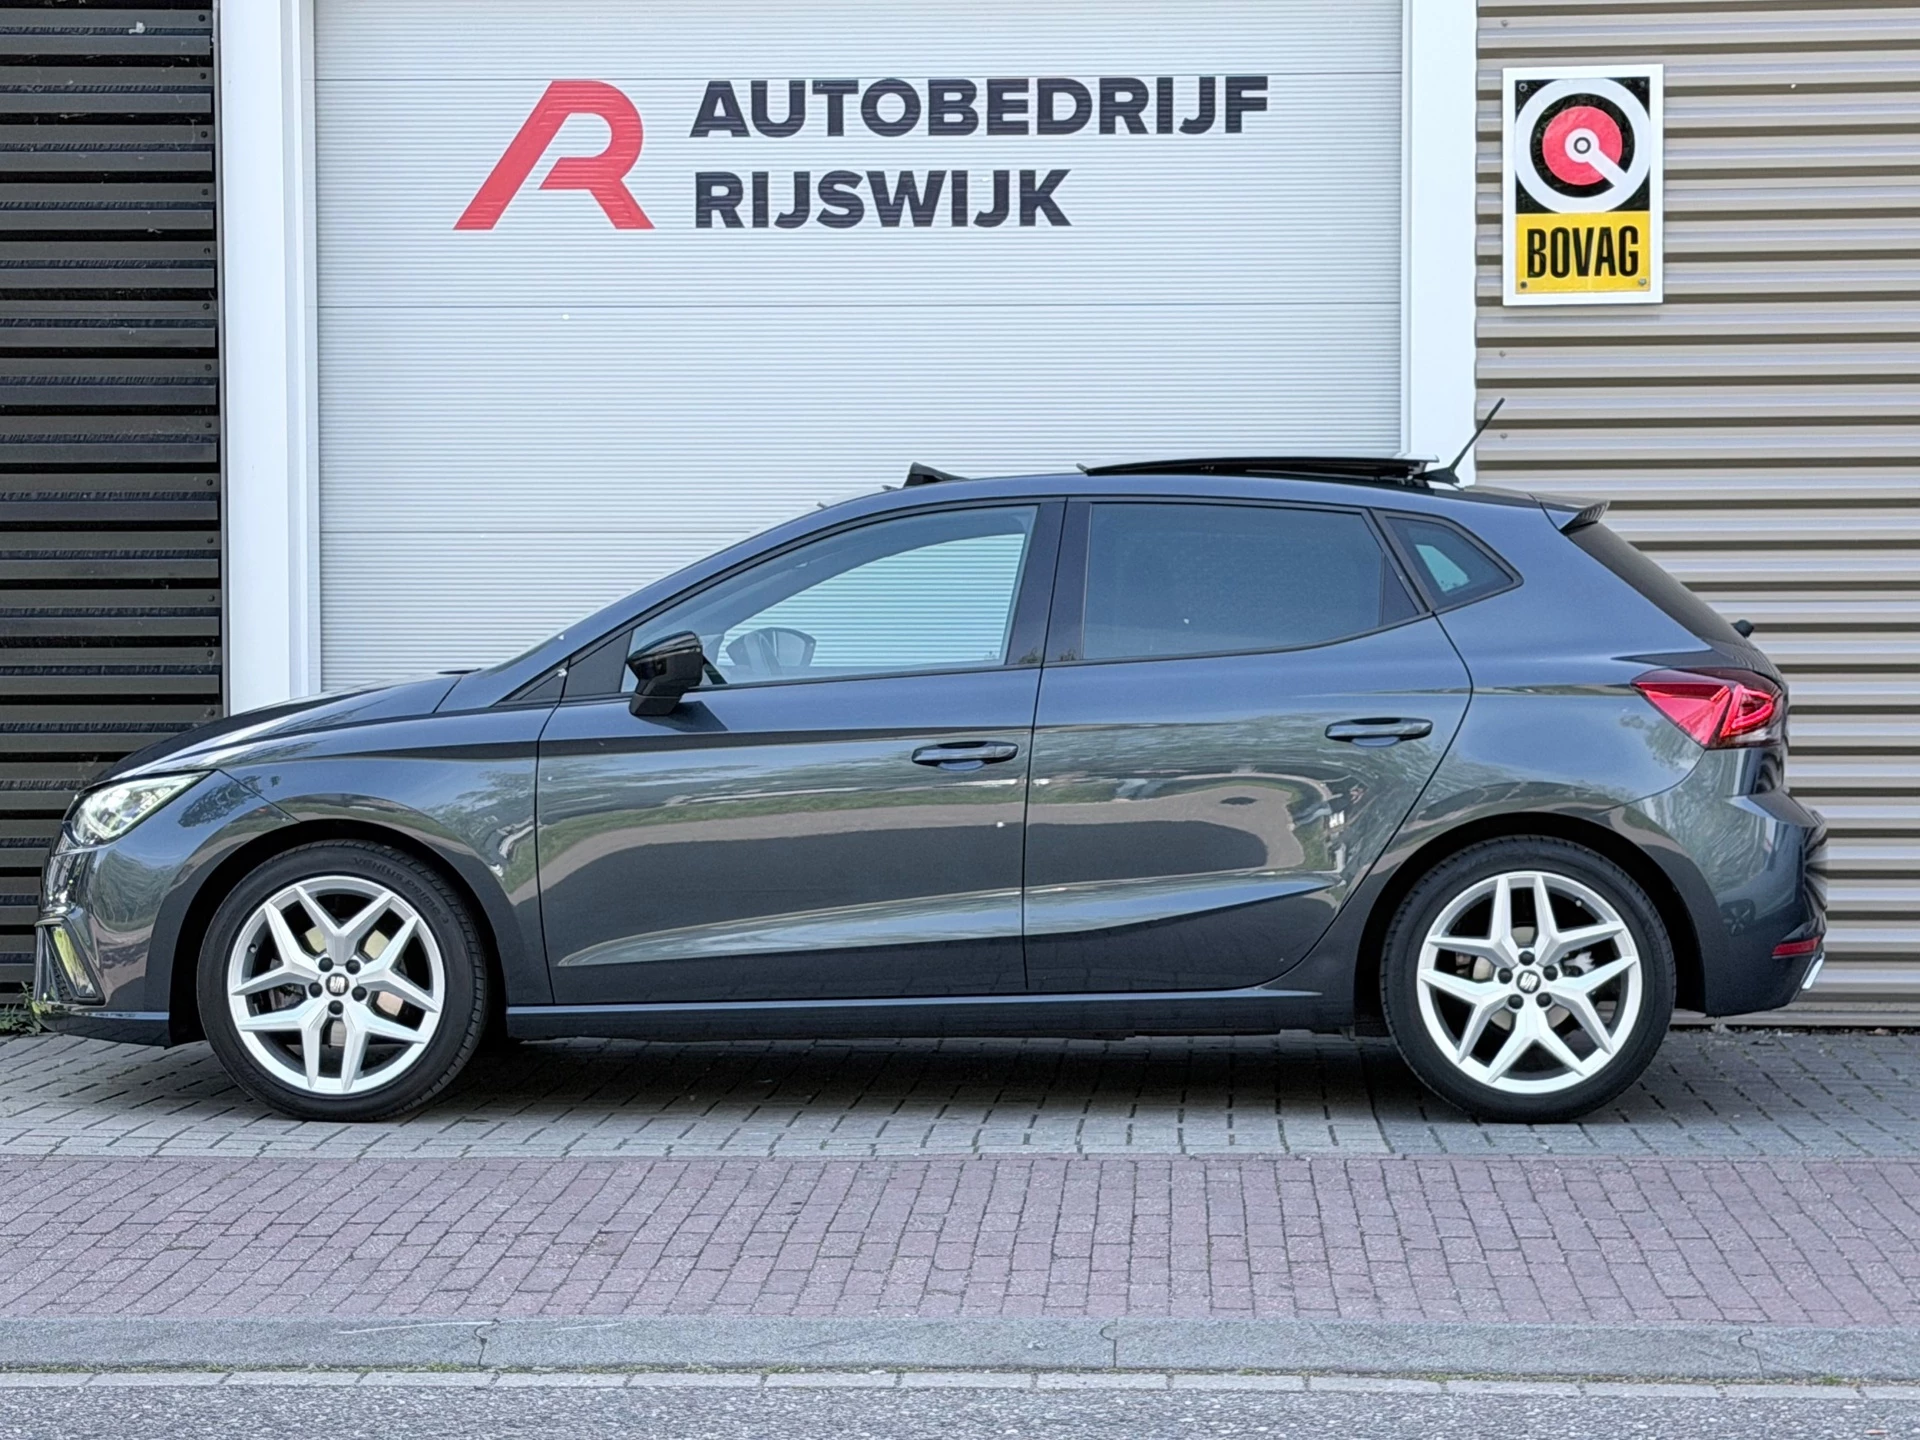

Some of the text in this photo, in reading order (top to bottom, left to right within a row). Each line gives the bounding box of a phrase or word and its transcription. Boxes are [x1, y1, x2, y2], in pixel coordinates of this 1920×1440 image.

[689, 76, 1268, 138] AUTOBEDRIJF
[695, 169, 1072, 229] RIJSWIJK
[1527, 225, 1639, 278] BOVAG
